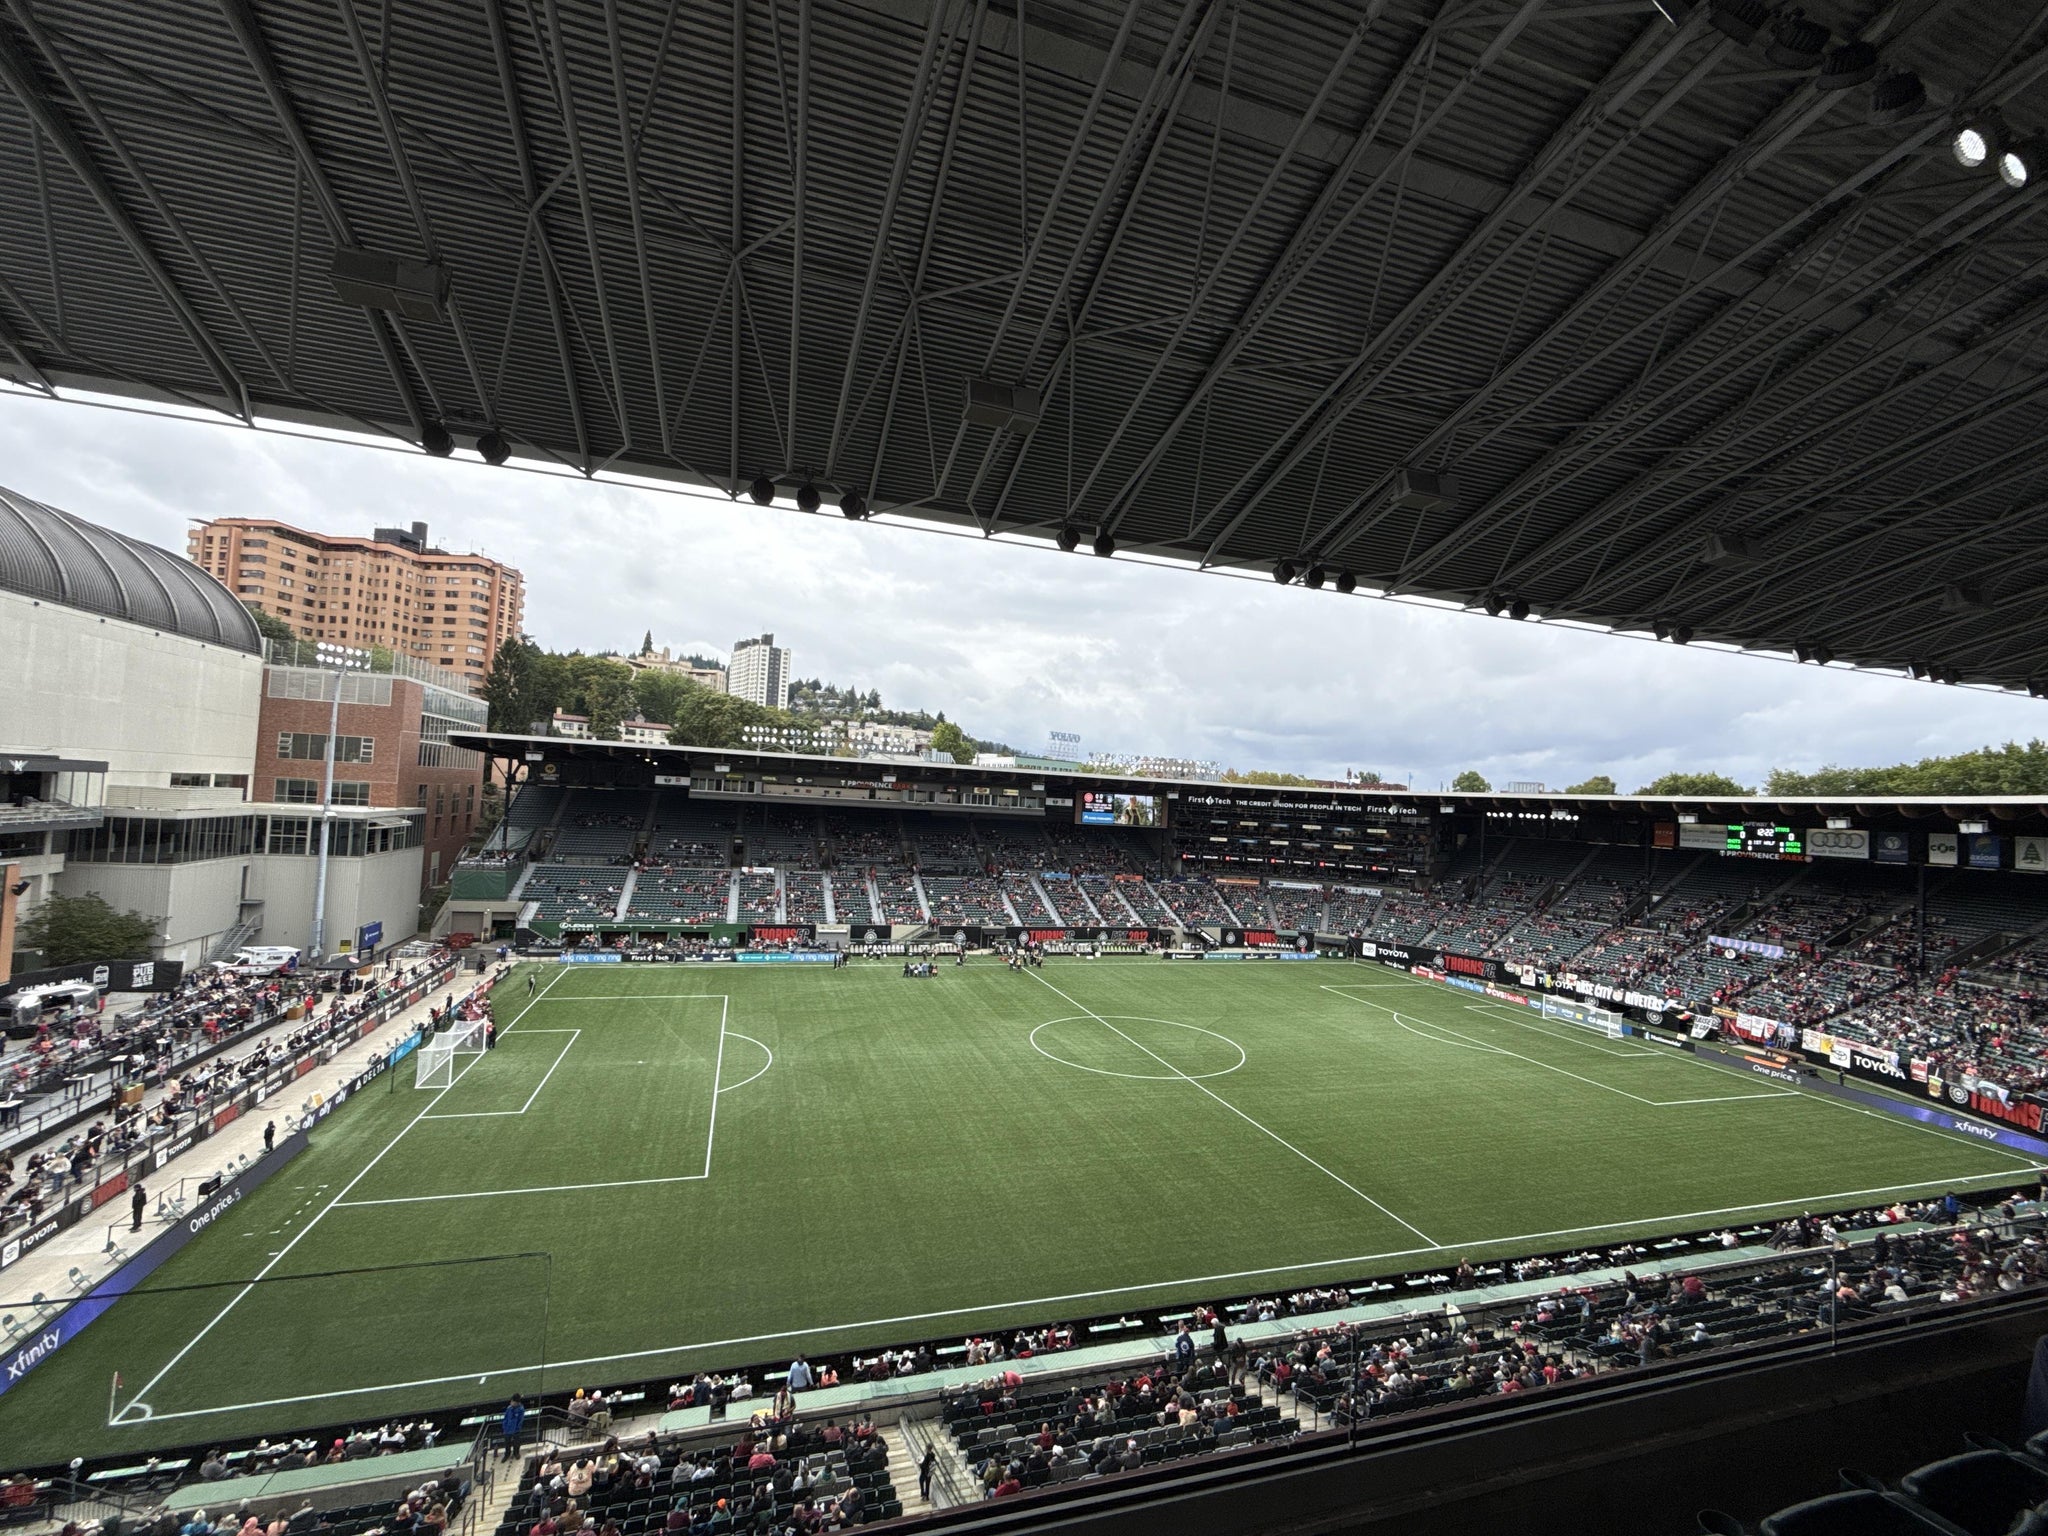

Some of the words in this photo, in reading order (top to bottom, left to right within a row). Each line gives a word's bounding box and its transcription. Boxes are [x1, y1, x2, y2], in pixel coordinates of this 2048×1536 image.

[1050, 731, 1081, 743] VOLVO
[1188, 795, 1205, 804] First
[1214, 797, 1231, 805] Tech
[1366, 805, 1387, 814] First
[1739, 830, 1746, 839] 0
[1788, 832, 1795, 841] 0
[1726, 850, 1781, 860] PROVIDENCE
[754, 928, 798, 943] THORNS
[1029, 931, 1066, 941] THORNS
[1128, 931, 1149, 941] 2012
[1243, 931, 1277, 945] THORNS
[1377, 947, 1409, 959] TOYOTA
[132, 966, 154, 977] PUB
[1444, 955, 1484, 976] THORNS
[363, 1062, 385, 1083] DELTA
[1752, 1064, 1770, 1076] One
[1771, 1068, 1794, 1082] price.
[1954, 1121, 1998, 1140] xfinity
[168, 1137, 193, 1156] TOYOTA
[190, 1212, 210, 1233] One
[210, 1197, 235, 1219] price.
[22, 1221, 59, 1249] TOYOTA
[7, 1328, 62, 1381] xfinity
